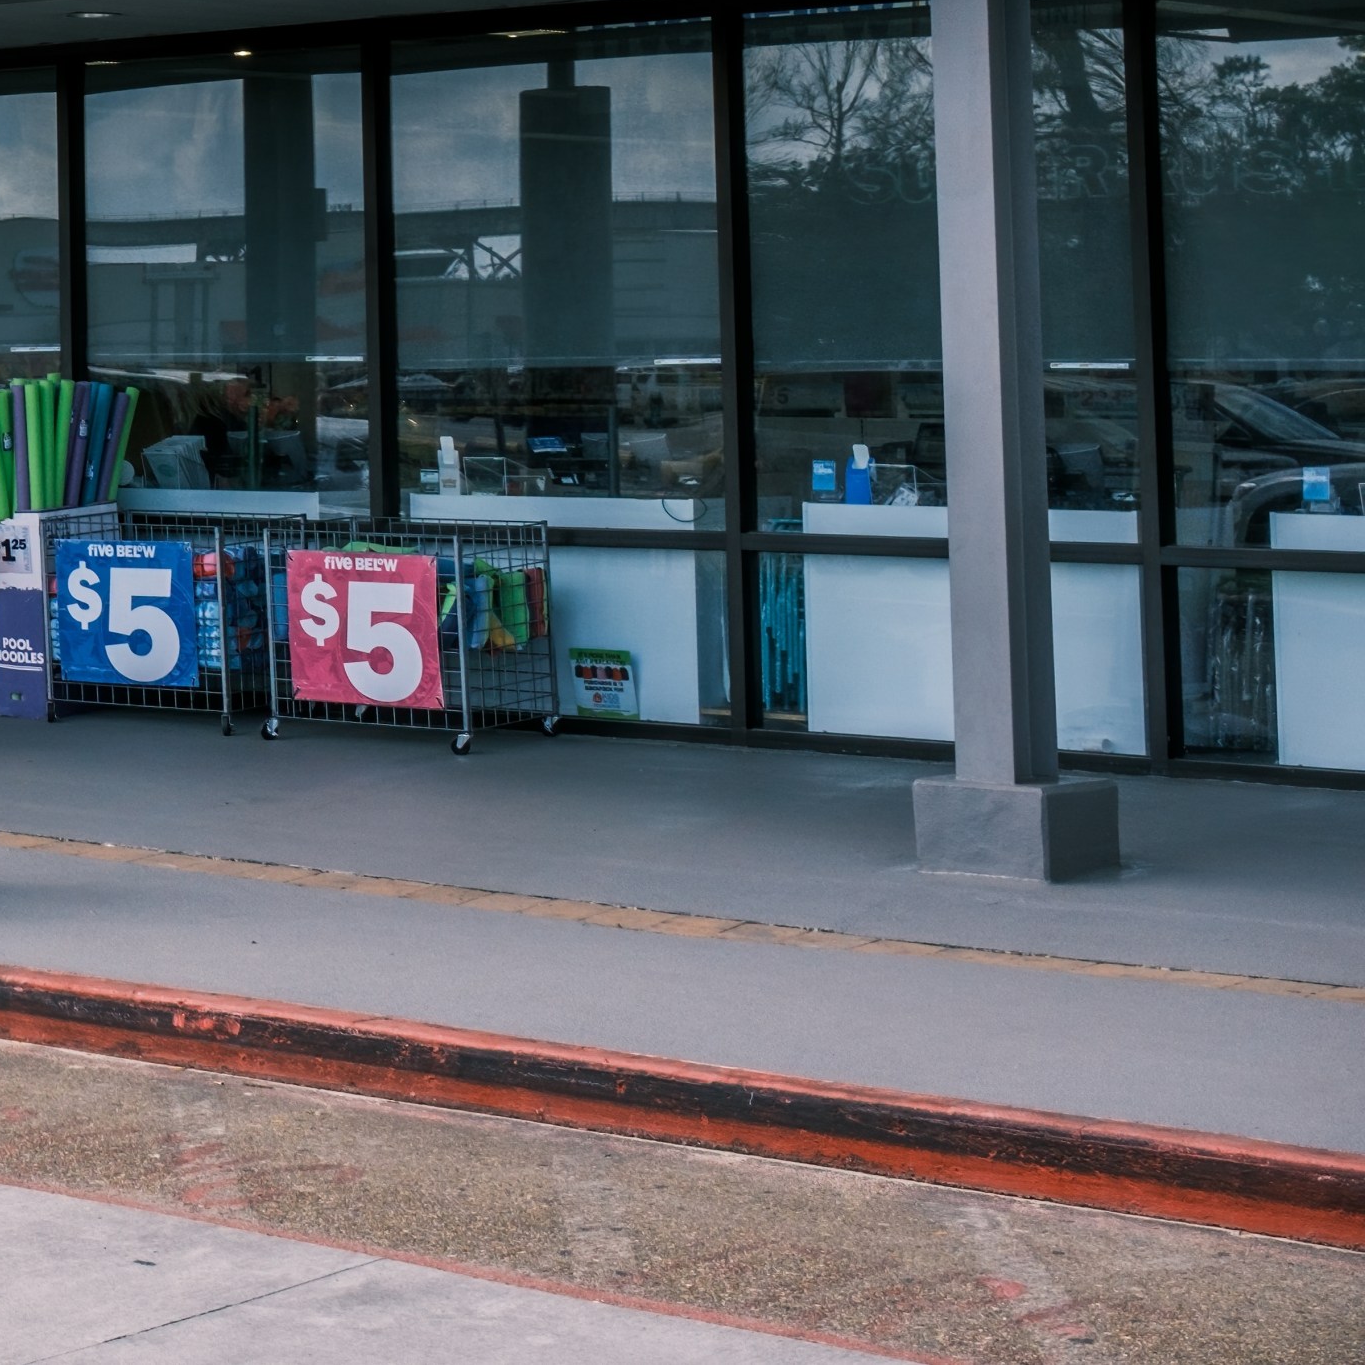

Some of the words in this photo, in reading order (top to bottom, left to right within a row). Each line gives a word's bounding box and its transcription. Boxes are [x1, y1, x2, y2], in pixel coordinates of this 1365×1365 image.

[87, 543, 115, 559] five
[116, 544, 156, 559] BELOW
[324, 555, 353, 571] five
[355, 556, 398, 572] BELOW
[66, 561, 181, 683] $5
[2, 637, 33, 651] POOL
[299, 573, 423, 703] $5
